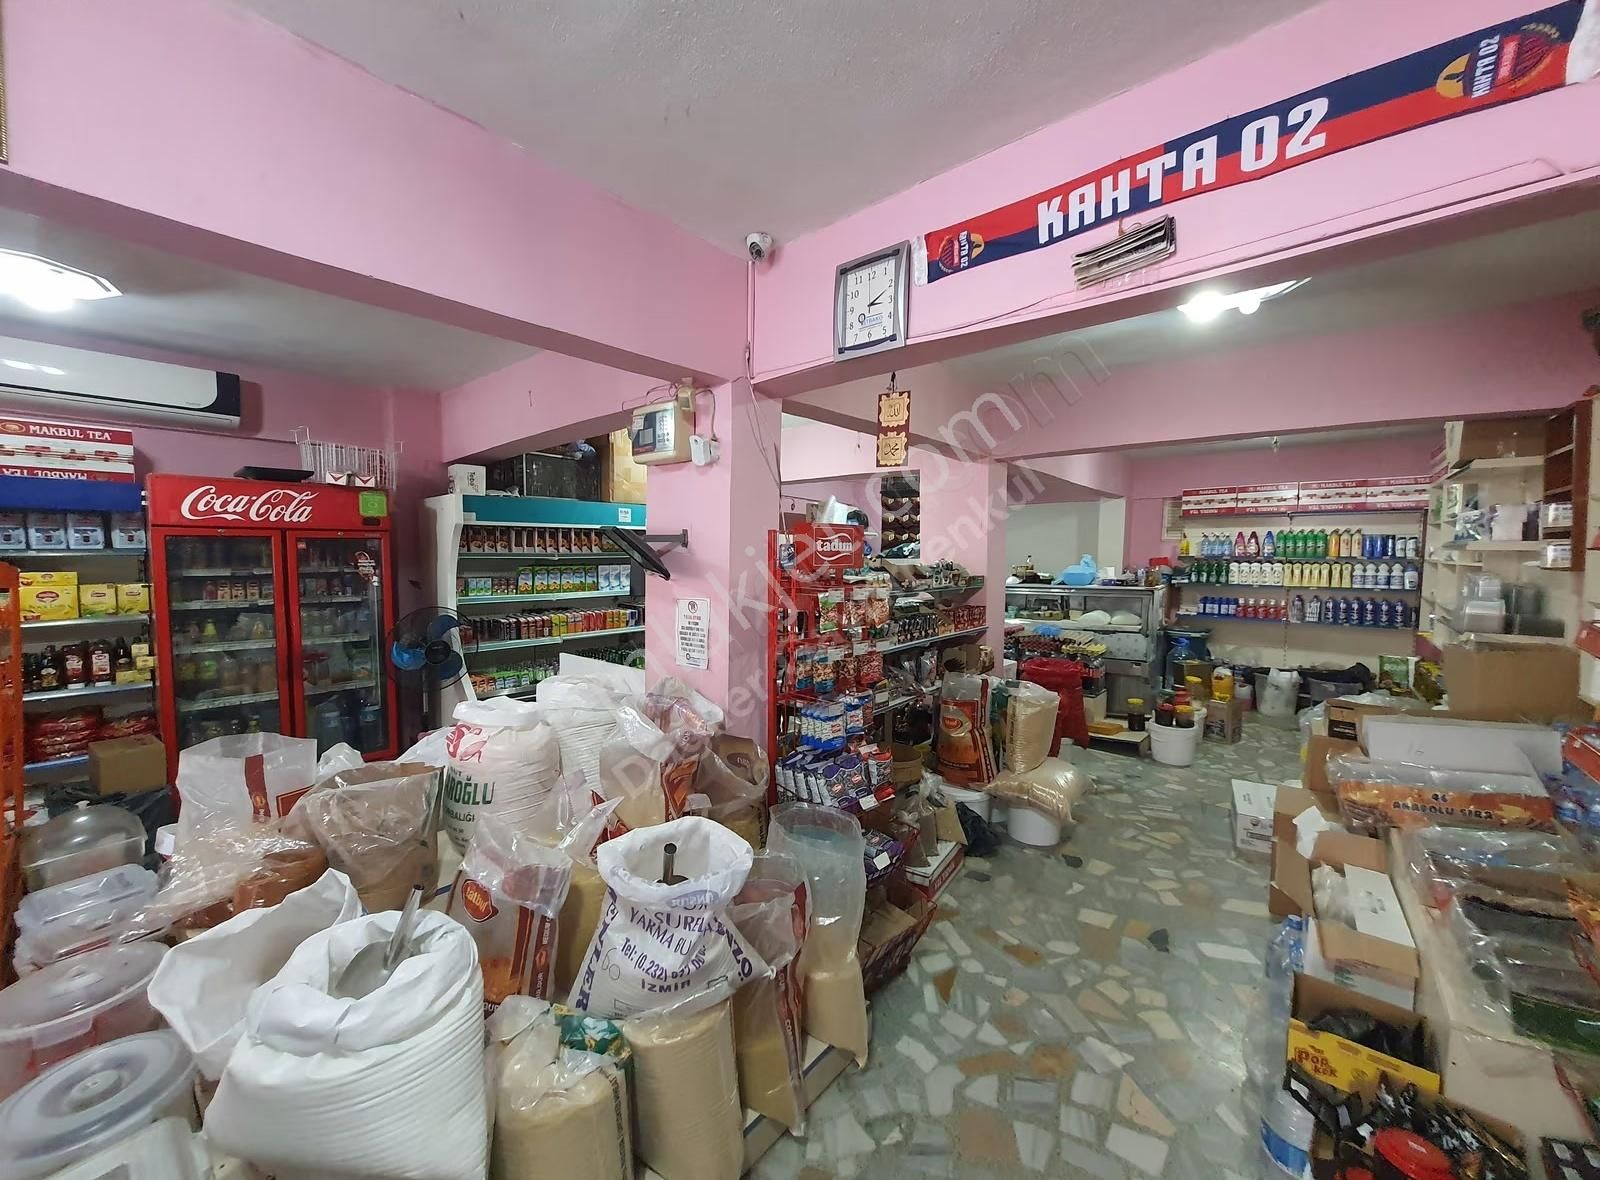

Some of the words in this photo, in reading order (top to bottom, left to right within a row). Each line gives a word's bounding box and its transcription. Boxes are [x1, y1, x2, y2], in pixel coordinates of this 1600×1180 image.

[1472, 55, 1497, 98] KAHTA
[1037, 134, 1218, 244] KAHTA
[1240, 97, 1329, 173] 02
[868, 271, 876, 280] 12
[884, 267, 887, 275] 1
[855, 276, 863, 285] 11
[888, 279, 893, 287] 2
[850, 291, 859, 300] 10
[888, 295, 893, 303] 3
[849, 307, 854, 315] 9
[849, 322, 854, 330] 8
[882, 326, 887, 334] 5
[854, 334, 858, 342] 7
[29, 425, 84, 439] MAKBUL
[86, 430, 112, 441] TEA
[181, 485, 319, 522] Coca-Cola
[630, 906, 674, 949] YARMA
[621, 937, 637, 961] Tel:
[634, 952, 668, 982] (0.232)
